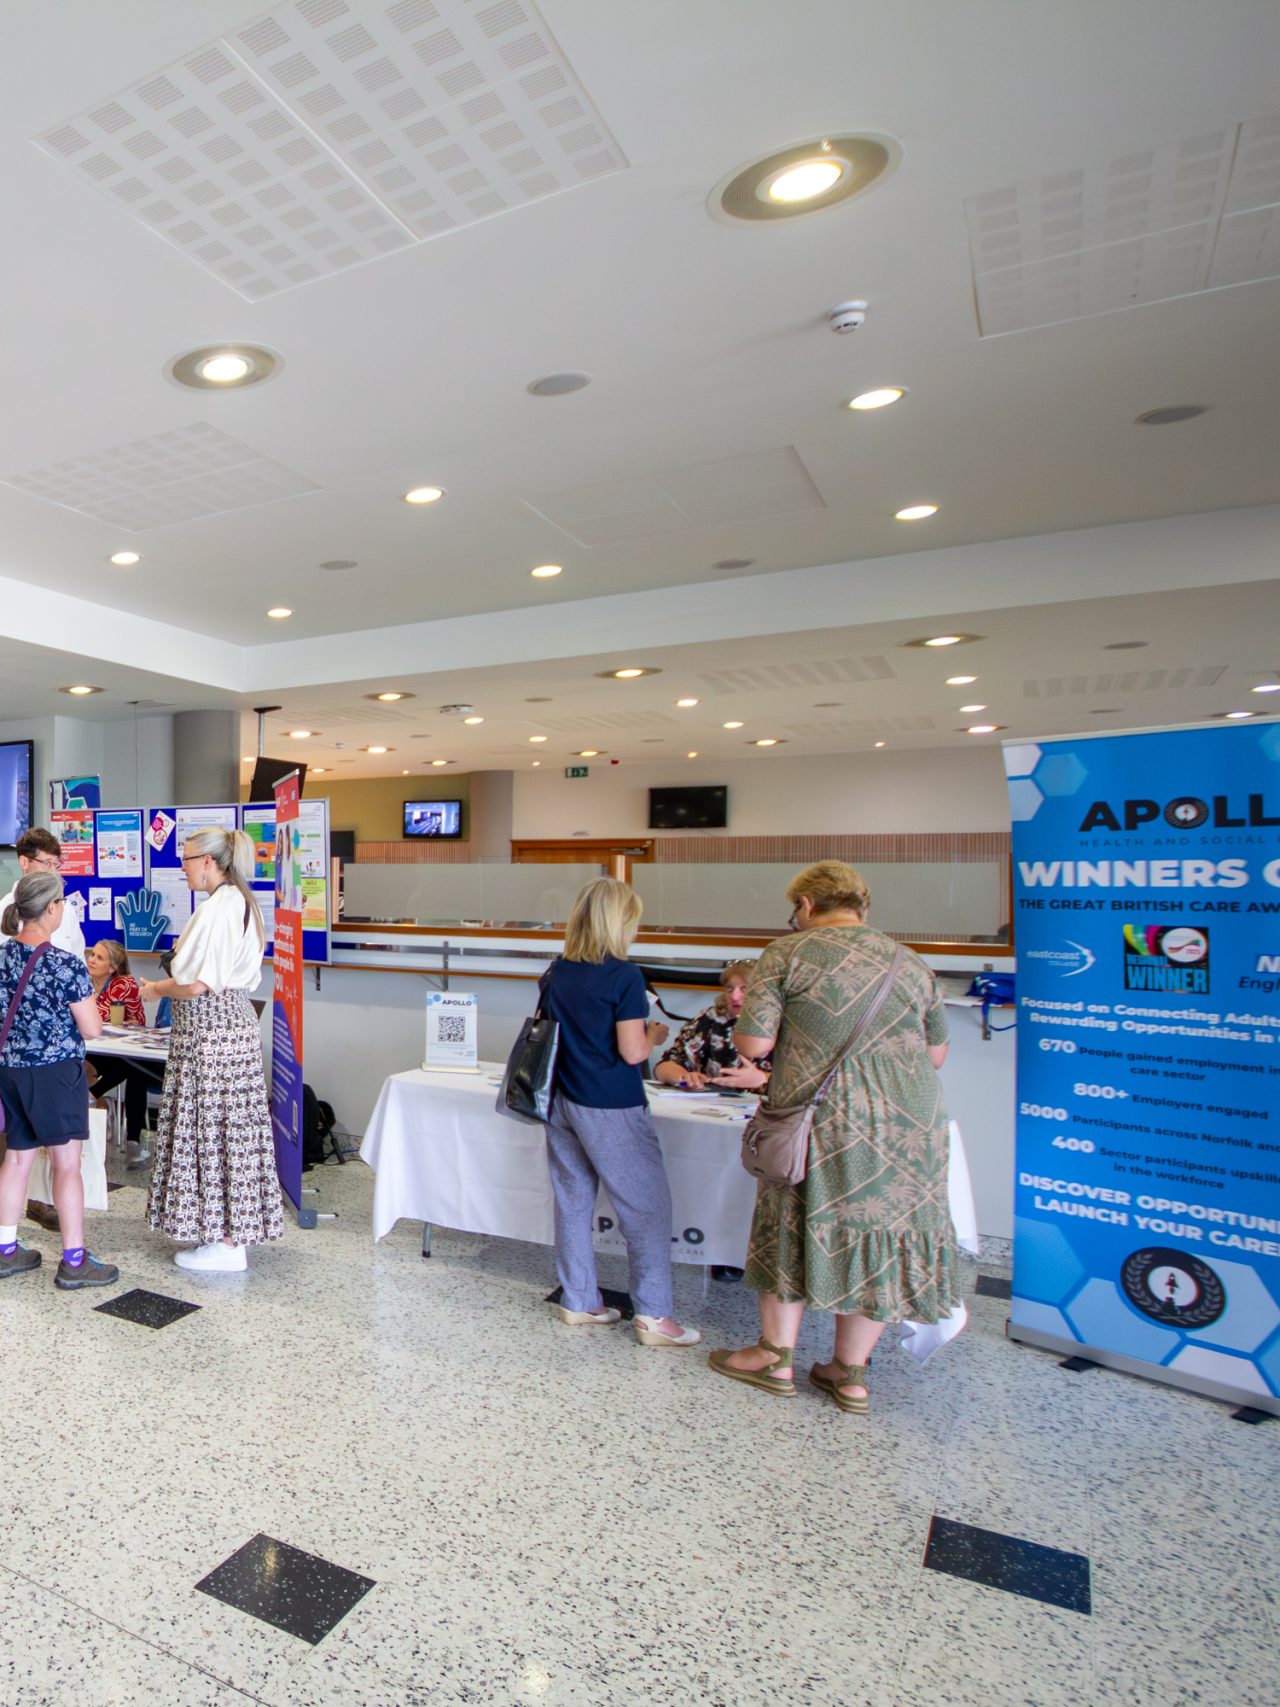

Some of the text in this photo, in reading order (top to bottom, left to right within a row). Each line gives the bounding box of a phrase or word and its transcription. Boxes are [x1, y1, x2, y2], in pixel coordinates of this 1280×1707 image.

[1078, 793, 1280, 833] APOLL
[1079, 838, 1144, 848] HEALTH
[1153, 836, 1190, 846] AND
[1200, 835, 1266, 845] SOCIAL
[1018, 859, 1250, 888] WINNERS
[1019, 898, 1046, 910] THE
[1049, 899, 1106, 910] GREAT
[1111, 899, 1184, 911] BRITISH
[1189, 900, 1241, 913] CARE
[1127, 965, 1208, 993] WINNER
[1021, 997, 1084, 1012] Focused
[1087, 1004, 1111, 1014] on
[1113, 1004, 1220, 1024] Connecting
[1030, 1012, 1274, 1043] Rewarding Opportunities in
[1038, 1038, 1077, 1054] 670
[1079, 1046, 1123, 1059] People
[1127, 1051, 1173, 1064] gained
[1176, 1057, 1265, 1074] employment
[1130, 1066, 1206, 1081] care sector
[1073, 1082, 1269, 1120] 800+ Employers engaged
[1020, 1102, 1069, 1121] 5000
[1072, 1115, 1151, 1134] Participants
[1154, 1127, 1198, 1140] across
[1202, 1133, 1252, 1149] Norfolk
[1051, 1135, 1280, 1184] 400 Sector participants upskill
[1113, 1162, 1225, 1189] in the workforce
[1019, 1172, 1280, 1235] DISCOVER OPPORTUN
[1034, 1195, 1129, 1226] LAUNCH
[1133, 1214, 1204, 1241] YOUR
